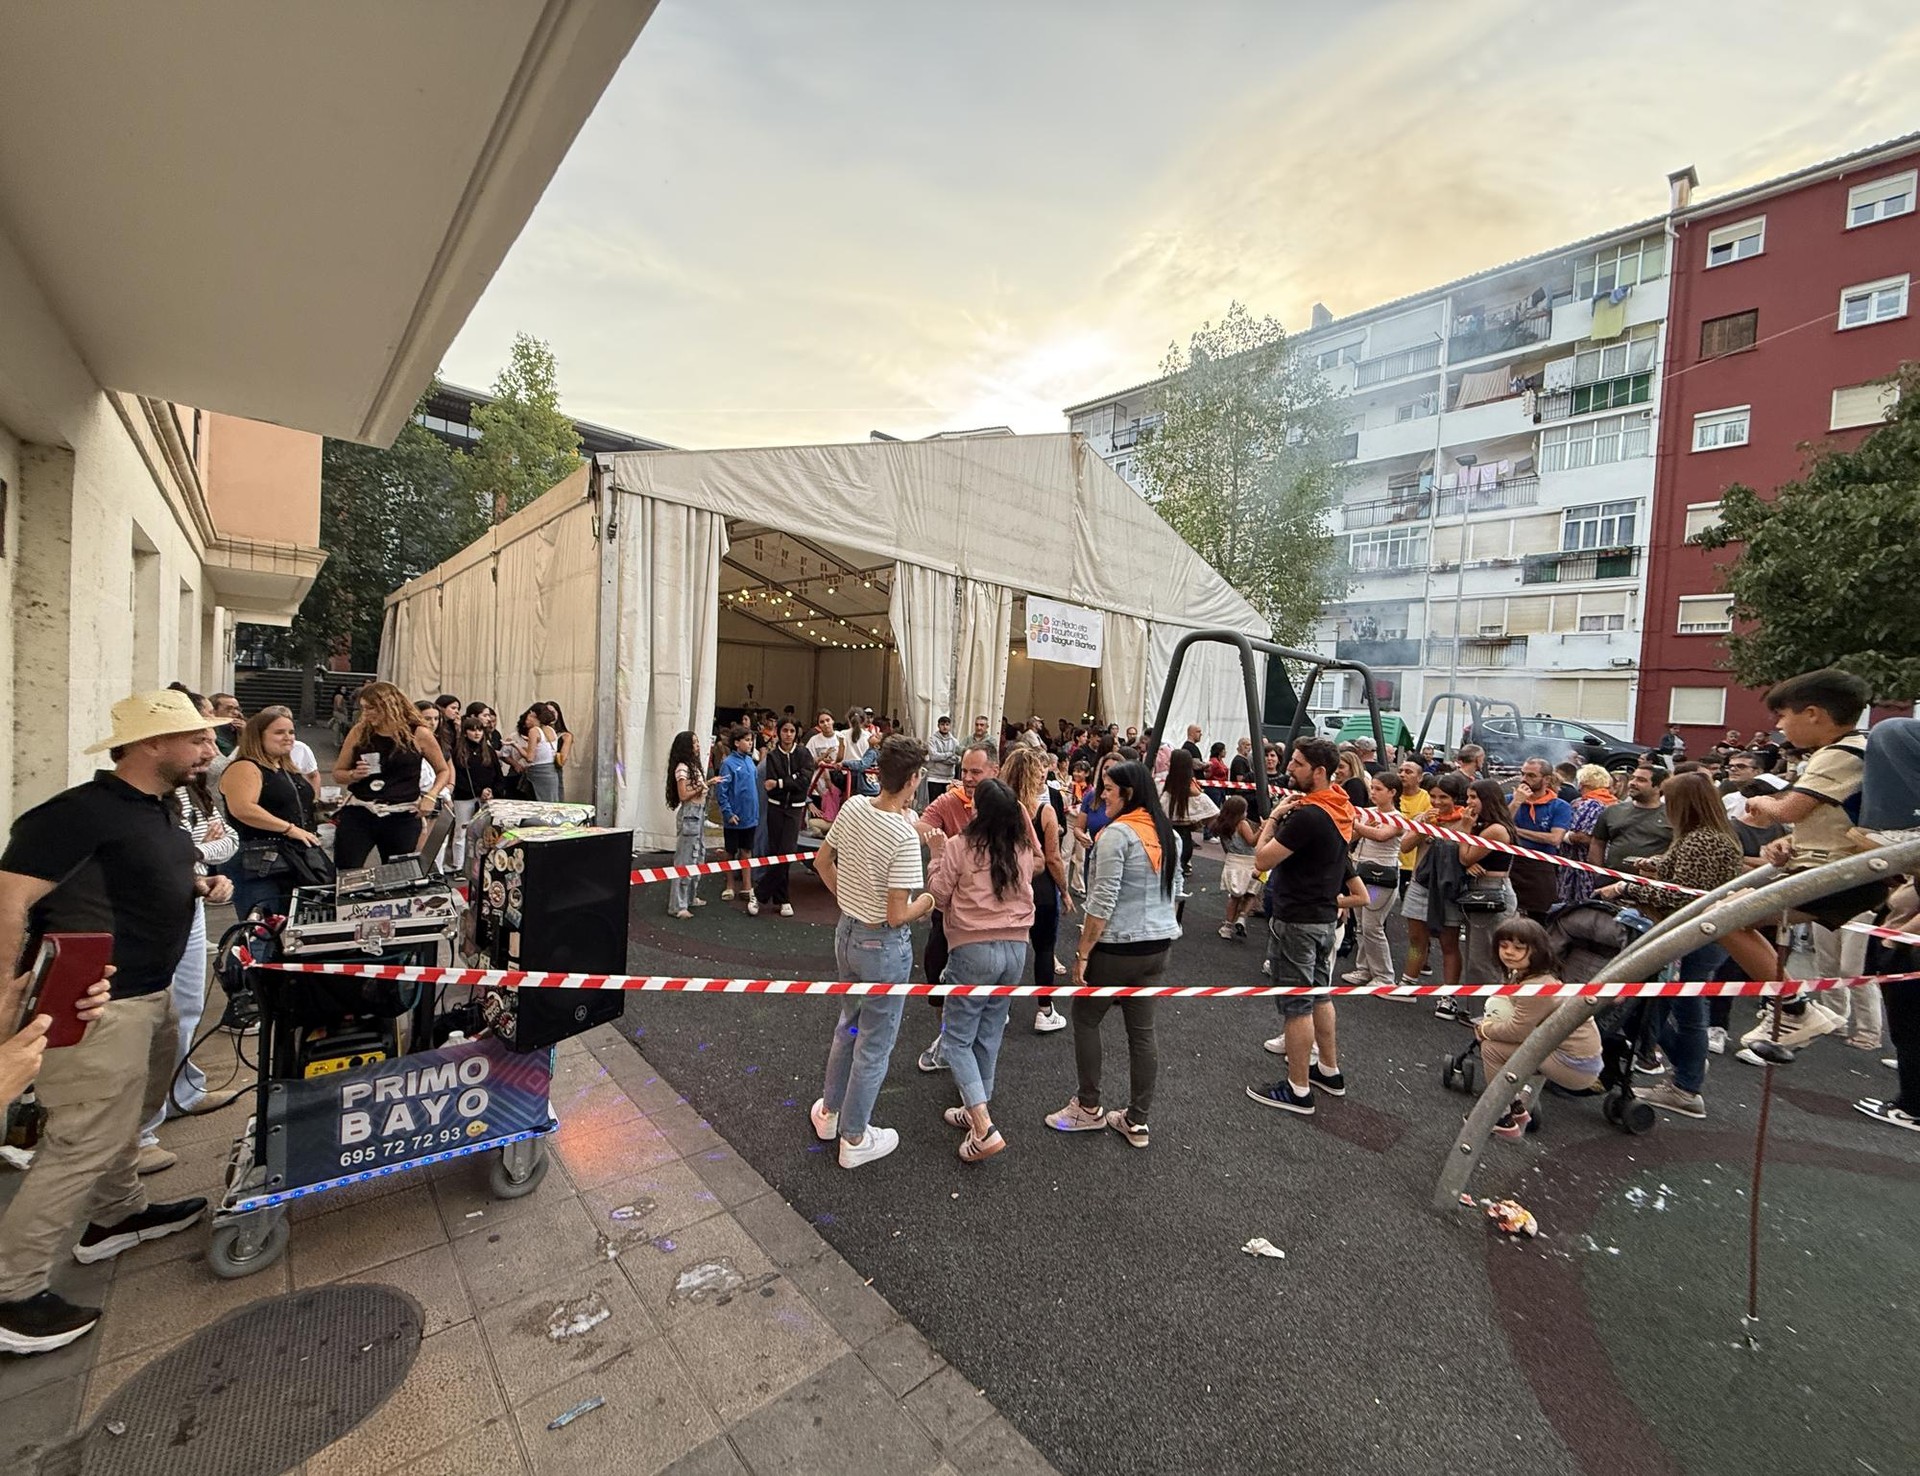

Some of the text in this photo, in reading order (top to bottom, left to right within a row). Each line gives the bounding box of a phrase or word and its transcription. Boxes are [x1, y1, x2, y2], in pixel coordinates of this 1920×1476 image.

[342, 1056, 490, 1108] PRIMO
[341, 1087, 489, 1145] BAYO
[340, 1127, 461, 1167] 695 72 72 93
